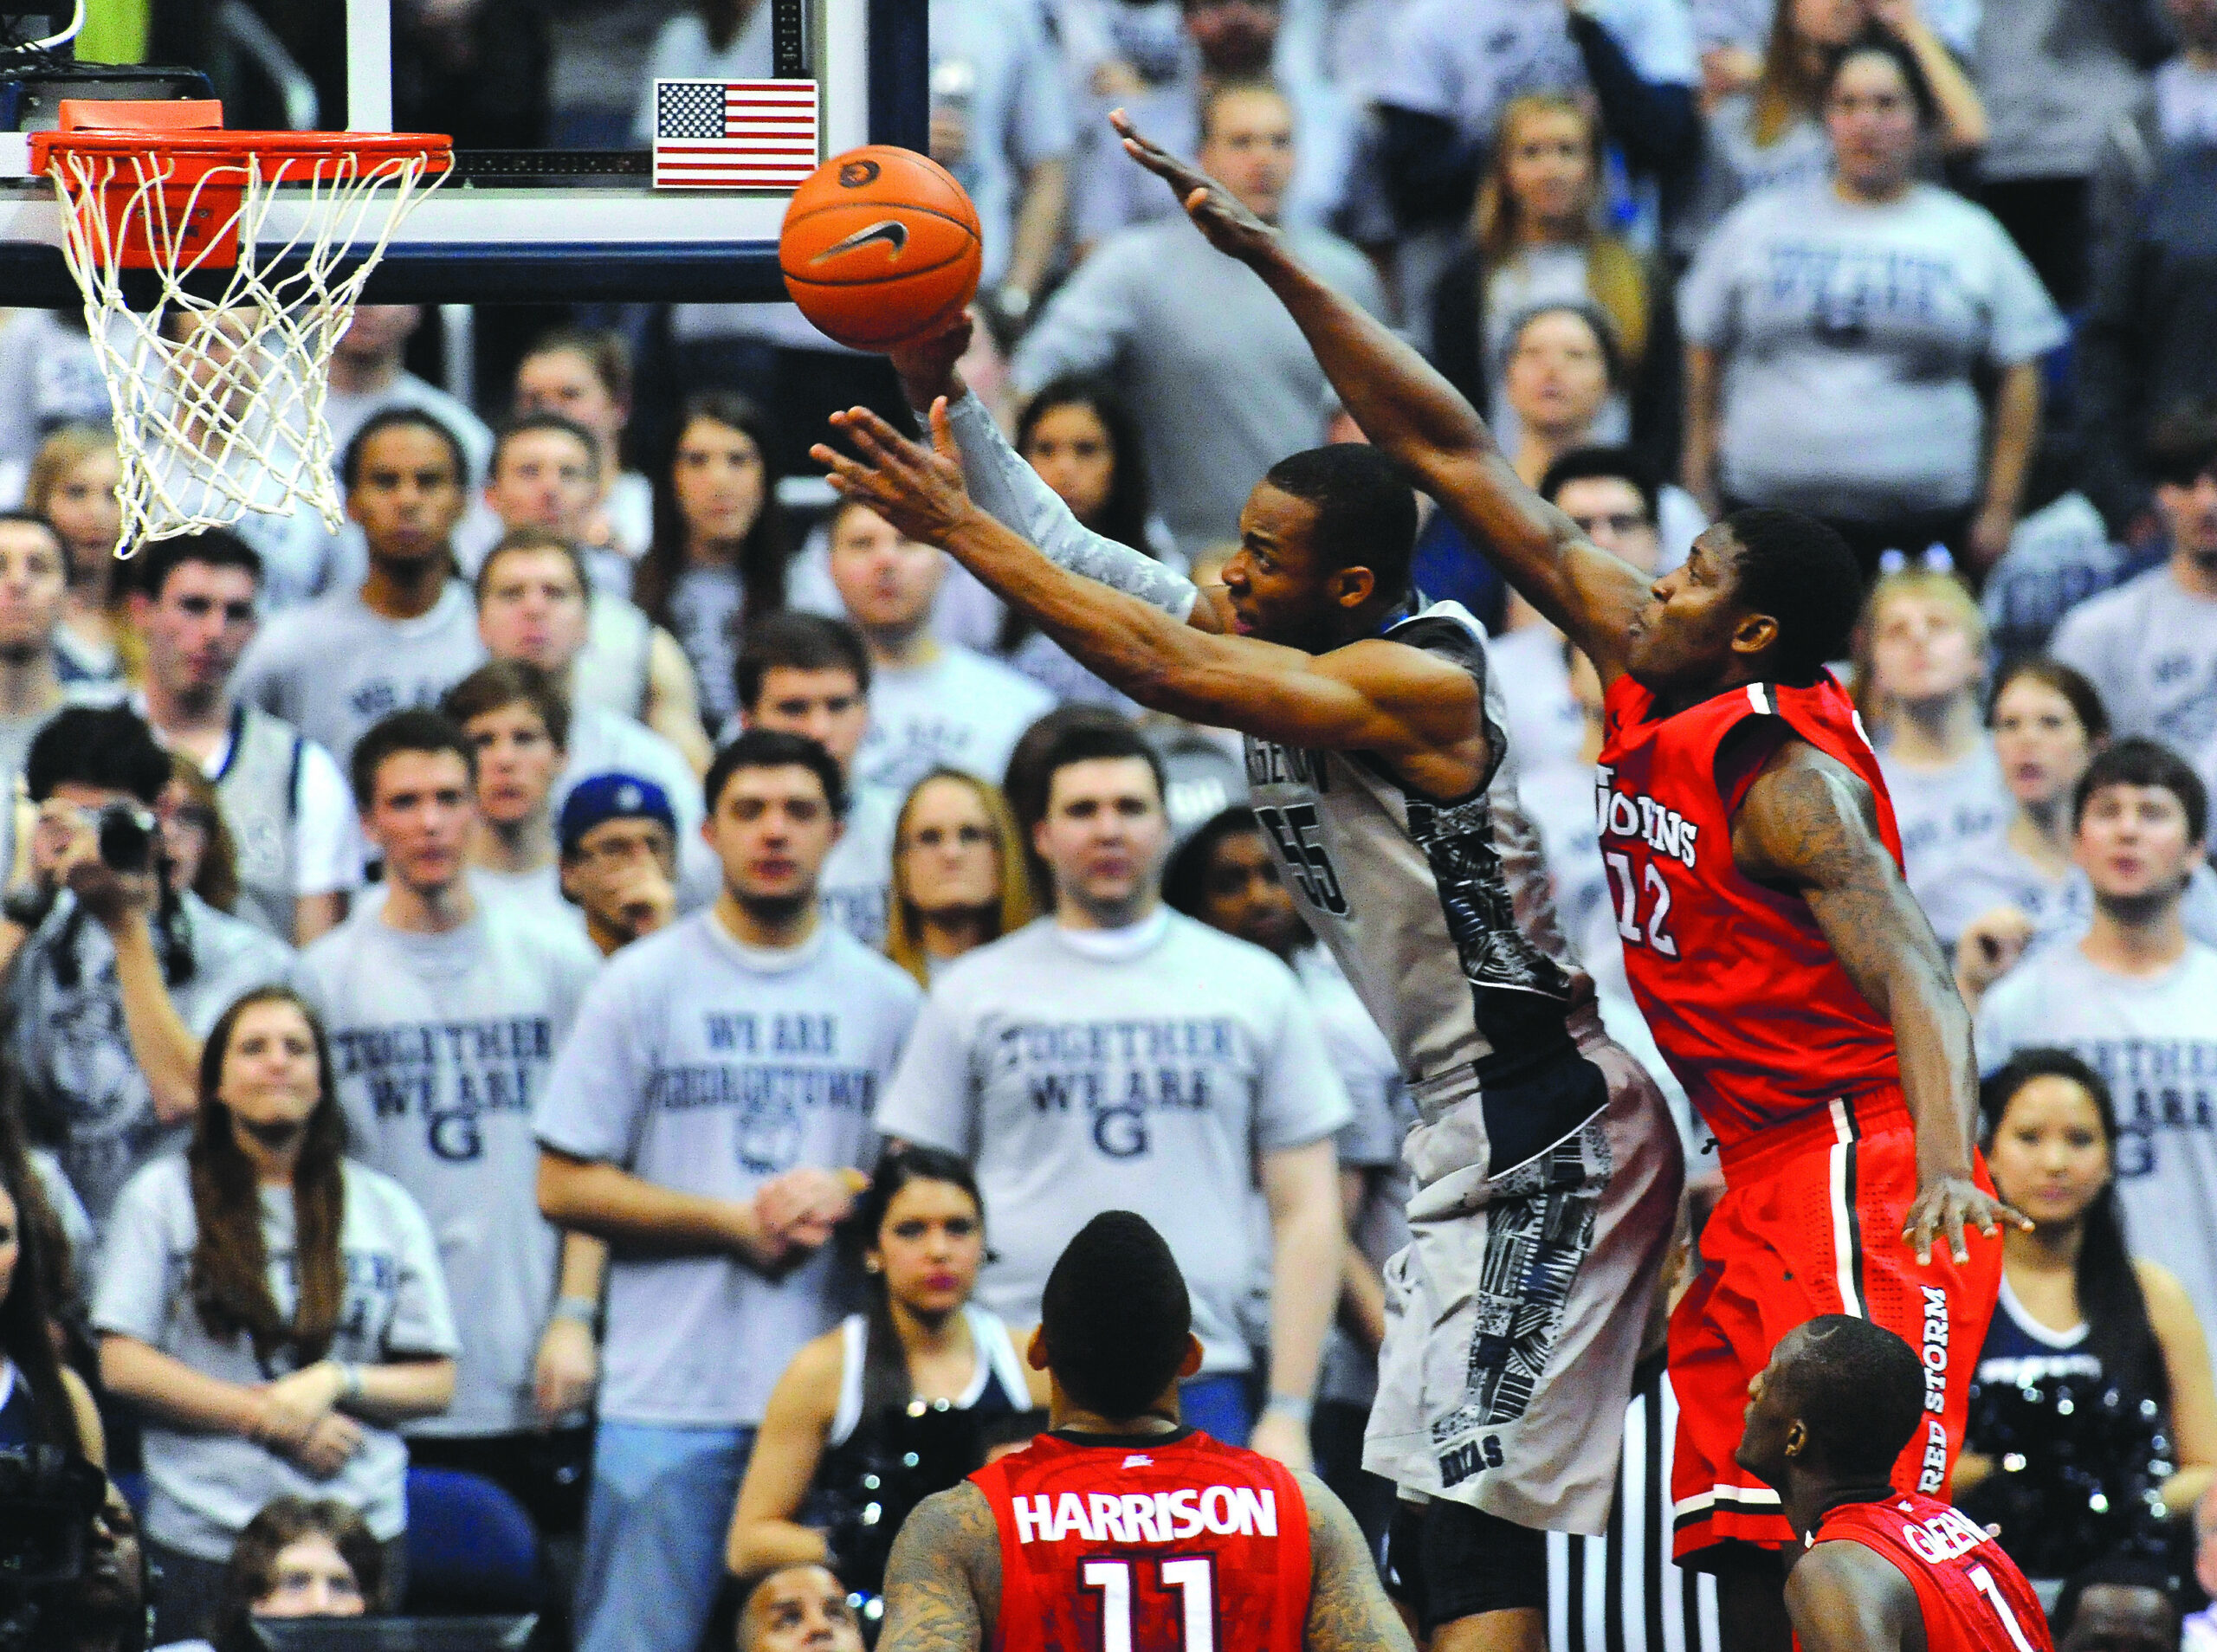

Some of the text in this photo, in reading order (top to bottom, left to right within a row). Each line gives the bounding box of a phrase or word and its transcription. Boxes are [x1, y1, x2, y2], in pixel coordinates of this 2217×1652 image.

[1253, 803, 1349, 918] 55
[1605, 850, 1680, 958] 12
[429, 1110, 482, 1161] G
[1093, 1105, 1148, 1158] G
[1916, 1283, 1949, 1496] RED STORM
[1012, 1484, 1279, 1545] HARRISON
[1081, 1554, 1219, 1652] 11
